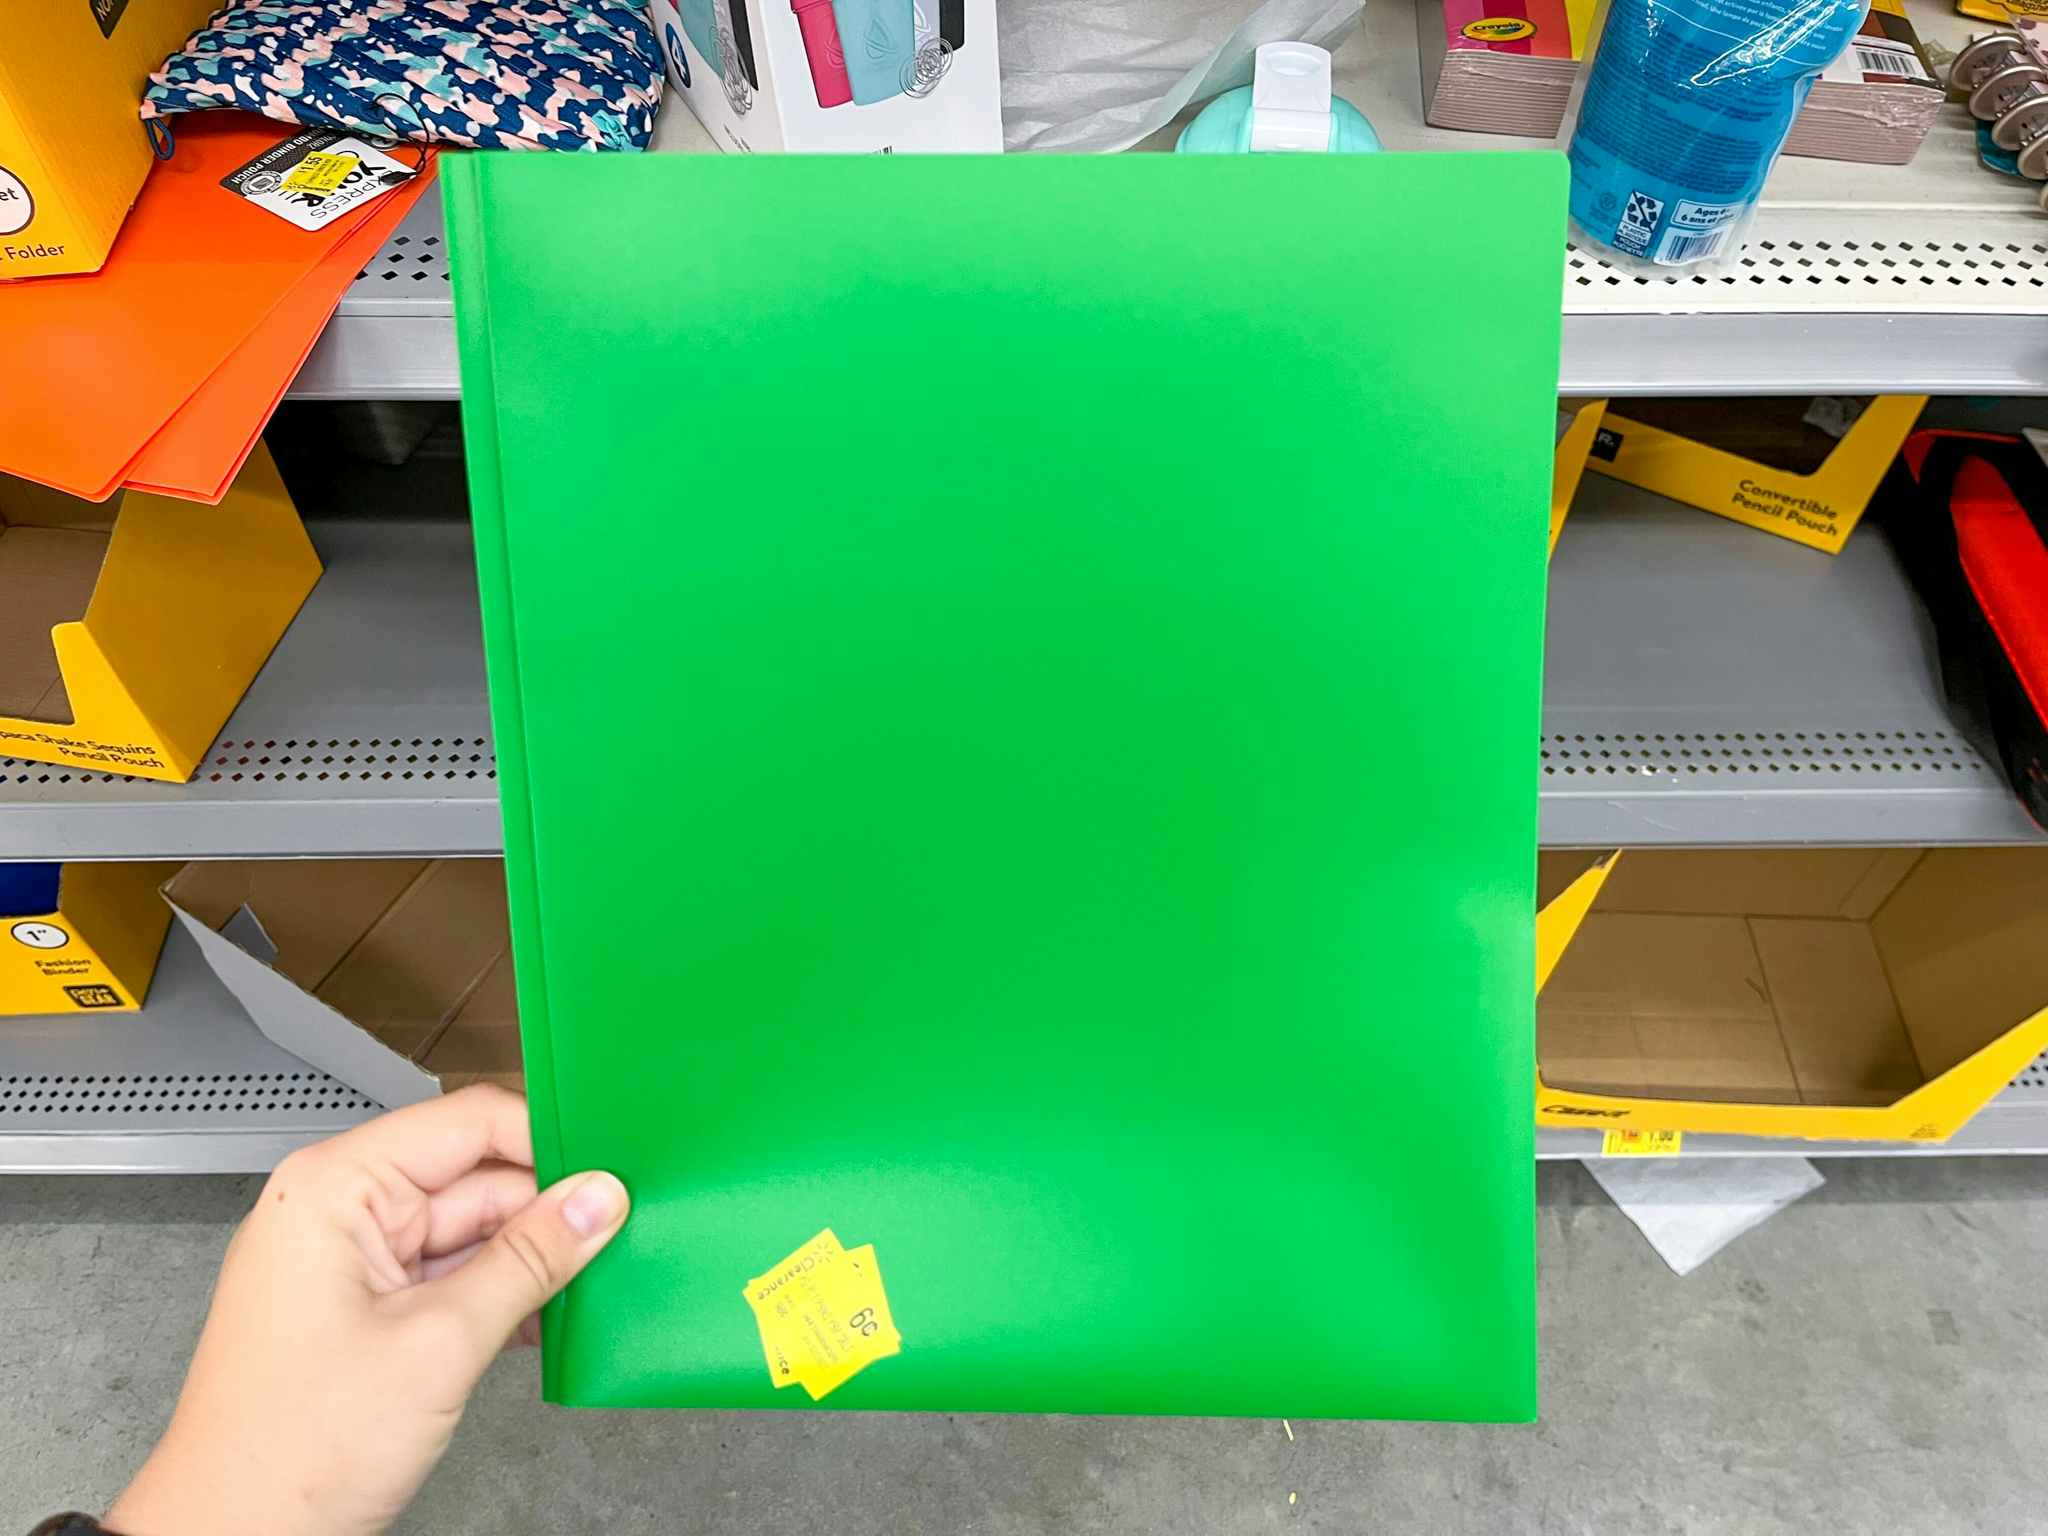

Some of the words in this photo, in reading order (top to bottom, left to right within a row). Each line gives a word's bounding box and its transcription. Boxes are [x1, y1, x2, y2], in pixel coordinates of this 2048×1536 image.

[231, 164, 264, 185] POUCH
[291, 160, 387, 208] YOR
[1694, 208, 1719, 217] Ages
[4, 243, 65, 260] Folder
[1739, 479, 1837, 520] Convertible
[1731, 492, 1783, 516] Pencil
[1785, 509, 1838, 537] Pouch
[36, 733, 87, 748] Shake
[87, 741, 156, 755] Sequins
[58, 747, 109, 761] Pencil
[109, 754, 165, 768] Pouch
[35, 959, 92, 968] Fashion
[42, 968, 89, 976] Binder
[758, 1256, 816, 1300] Clearance
